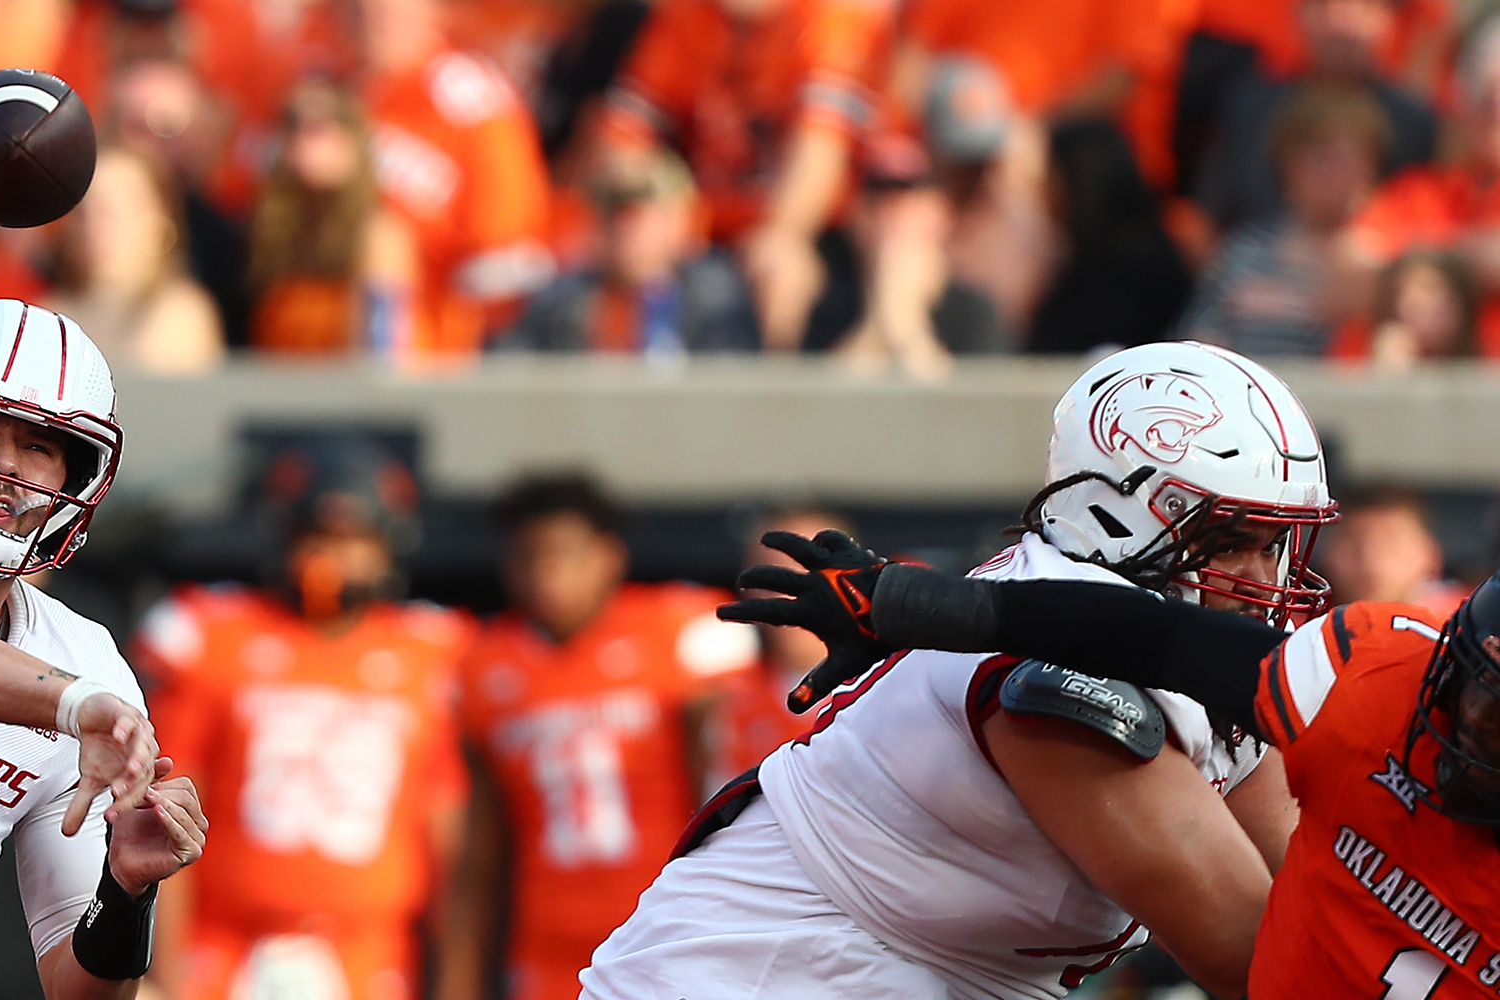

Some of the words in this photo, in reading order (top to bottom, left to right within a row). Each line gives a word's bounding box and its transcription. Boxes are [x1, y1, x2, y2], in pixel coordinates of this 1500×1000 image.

[1061, 674, 1143, 732] GEAR
[1333, 824, 1480, 966] OKLAHOMA
[1478, 951, 1500, 996] S
